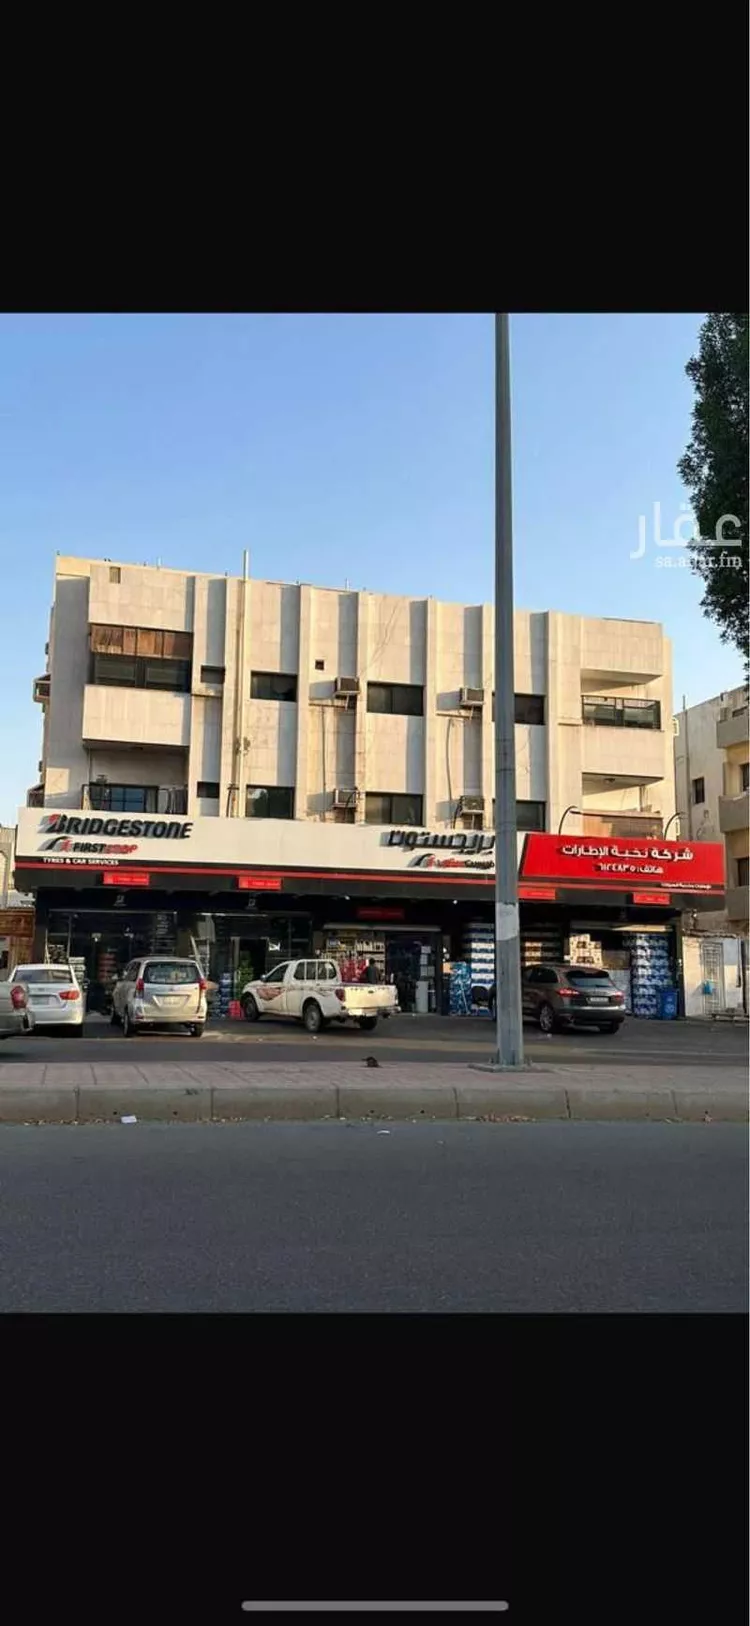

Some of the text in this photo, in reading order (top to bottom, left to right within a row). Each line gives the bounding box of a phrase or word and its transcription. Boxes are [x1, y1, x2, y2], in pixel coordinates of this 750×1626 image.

[43, 813, 193, 840] BRIDGESTONE
[562, 844, 693, 862] شركة نخبة الإطارات
